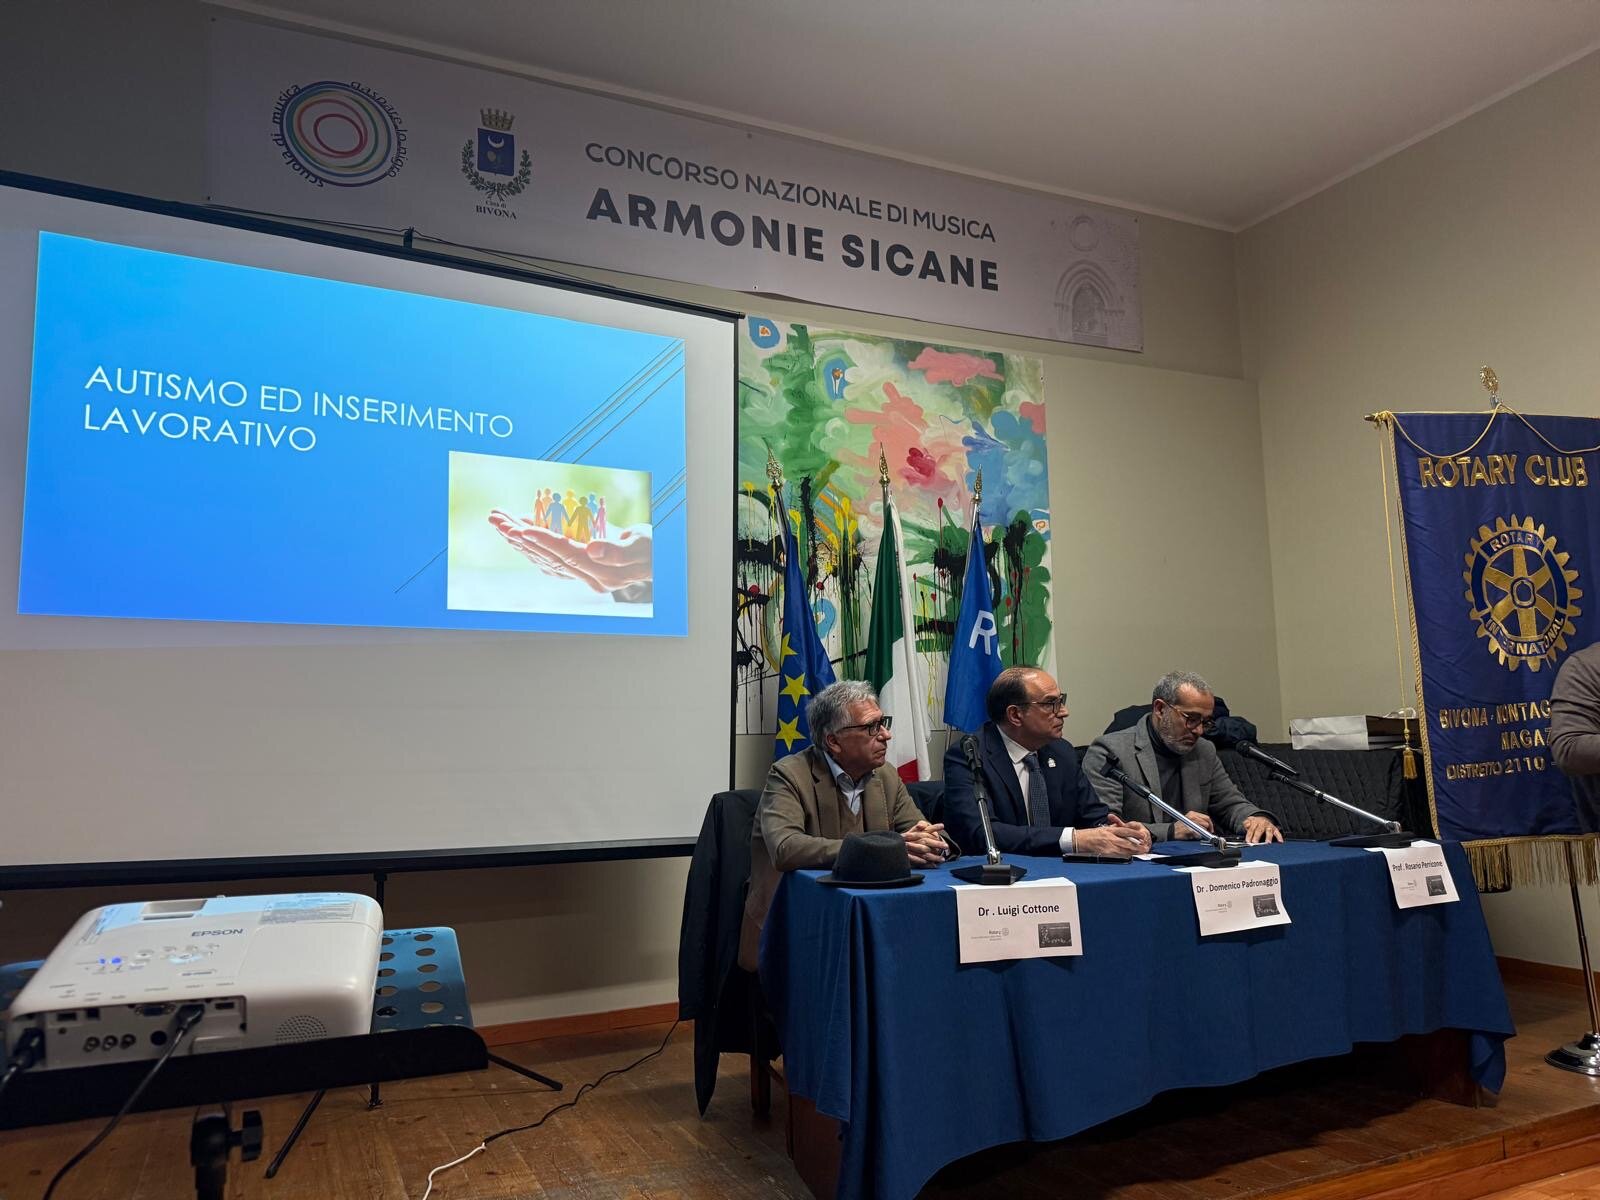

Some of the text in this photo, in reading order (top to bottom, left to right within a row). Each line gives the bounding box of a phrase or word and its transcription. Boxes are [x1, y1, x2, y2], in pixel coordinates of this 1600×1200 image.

[271, 84, 325, 188] scuola di musica
[585, 142, 996, 243] CONCORSO NAZIONALE DI MUSICA
[475, 204, 518, 220] BIVONA
[586, 187, 999, 292] ARMONIE SICANE
[84, 364, 515, 439] AUTISMO ED INSERIMENTO
[84, 404, 318, 452] LAVORATIVO
[1417, 454, 1590, 489] ROTARY CLUB
[1489, 531, 1541, 552] ROTARY
[968, 609, 998, 656] R
[1439, 707, 1489, 729] BIVONA
[1496, 699, 1552, 724] MONTAG
[1446, 761, 1503, 780] DISTRETTO
[1504, 756, 1546, 774] 2110
[1209, 881, 1241, 892] Domenico
[1241, 877, 1279, 888] Padronaggio
[998, 904, 1020, 918] Luigi
[1022, 904, 1060, 915] Cottone
[191, 928, 243, 938] EPSON
